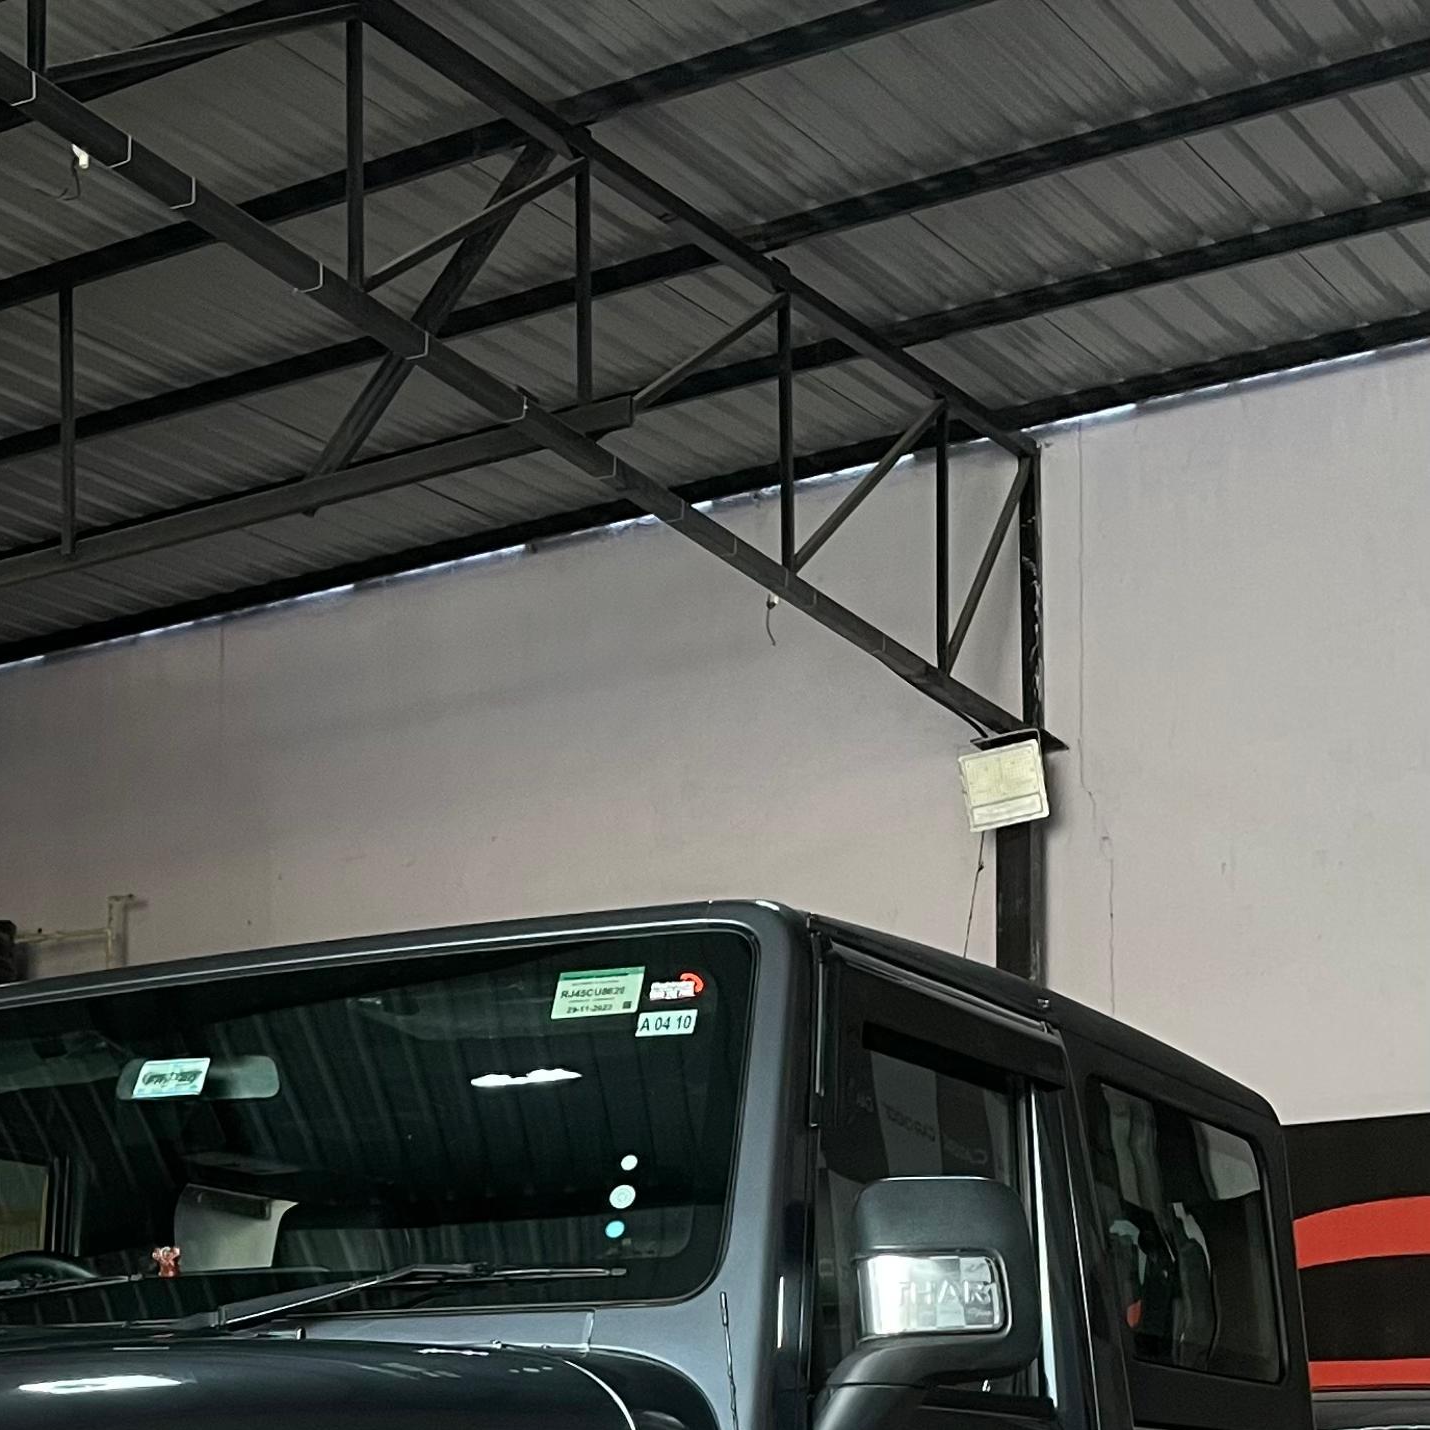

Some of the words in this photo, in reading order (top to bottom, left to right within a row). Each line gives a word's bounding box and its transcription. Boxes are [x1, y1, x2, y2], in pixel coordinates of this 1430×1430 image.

[639, 1017, 650, 1032] A
[654, 1016, 671, 1031] 04
[676, 1015, 692, 1030] 10
